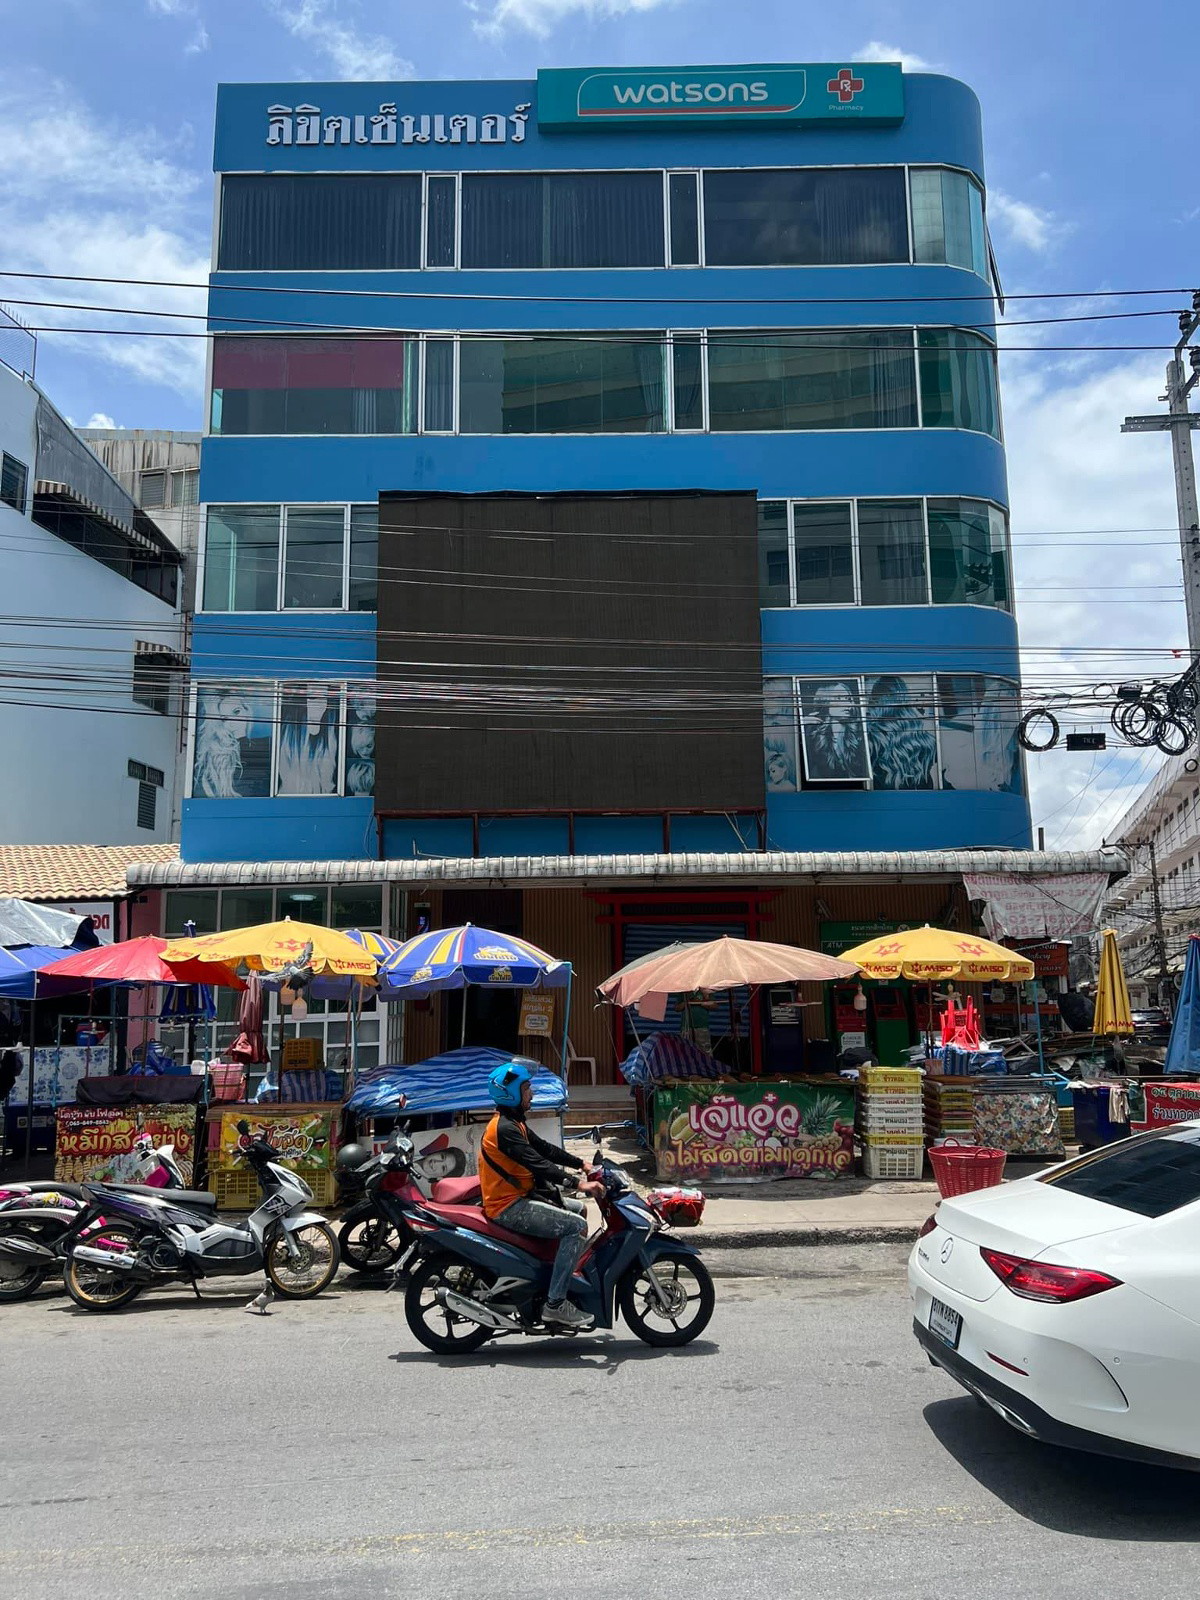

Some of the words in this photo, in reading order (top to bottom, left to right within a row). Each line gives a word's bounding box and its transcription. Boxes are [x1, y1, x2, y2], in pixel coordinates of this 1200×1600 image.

[613, 80, 769, 104] watsons
[828, 104, 864, 112] Pharmacy
[266, 102, 531, 145] ลิขิตเซ็นเตอร์
